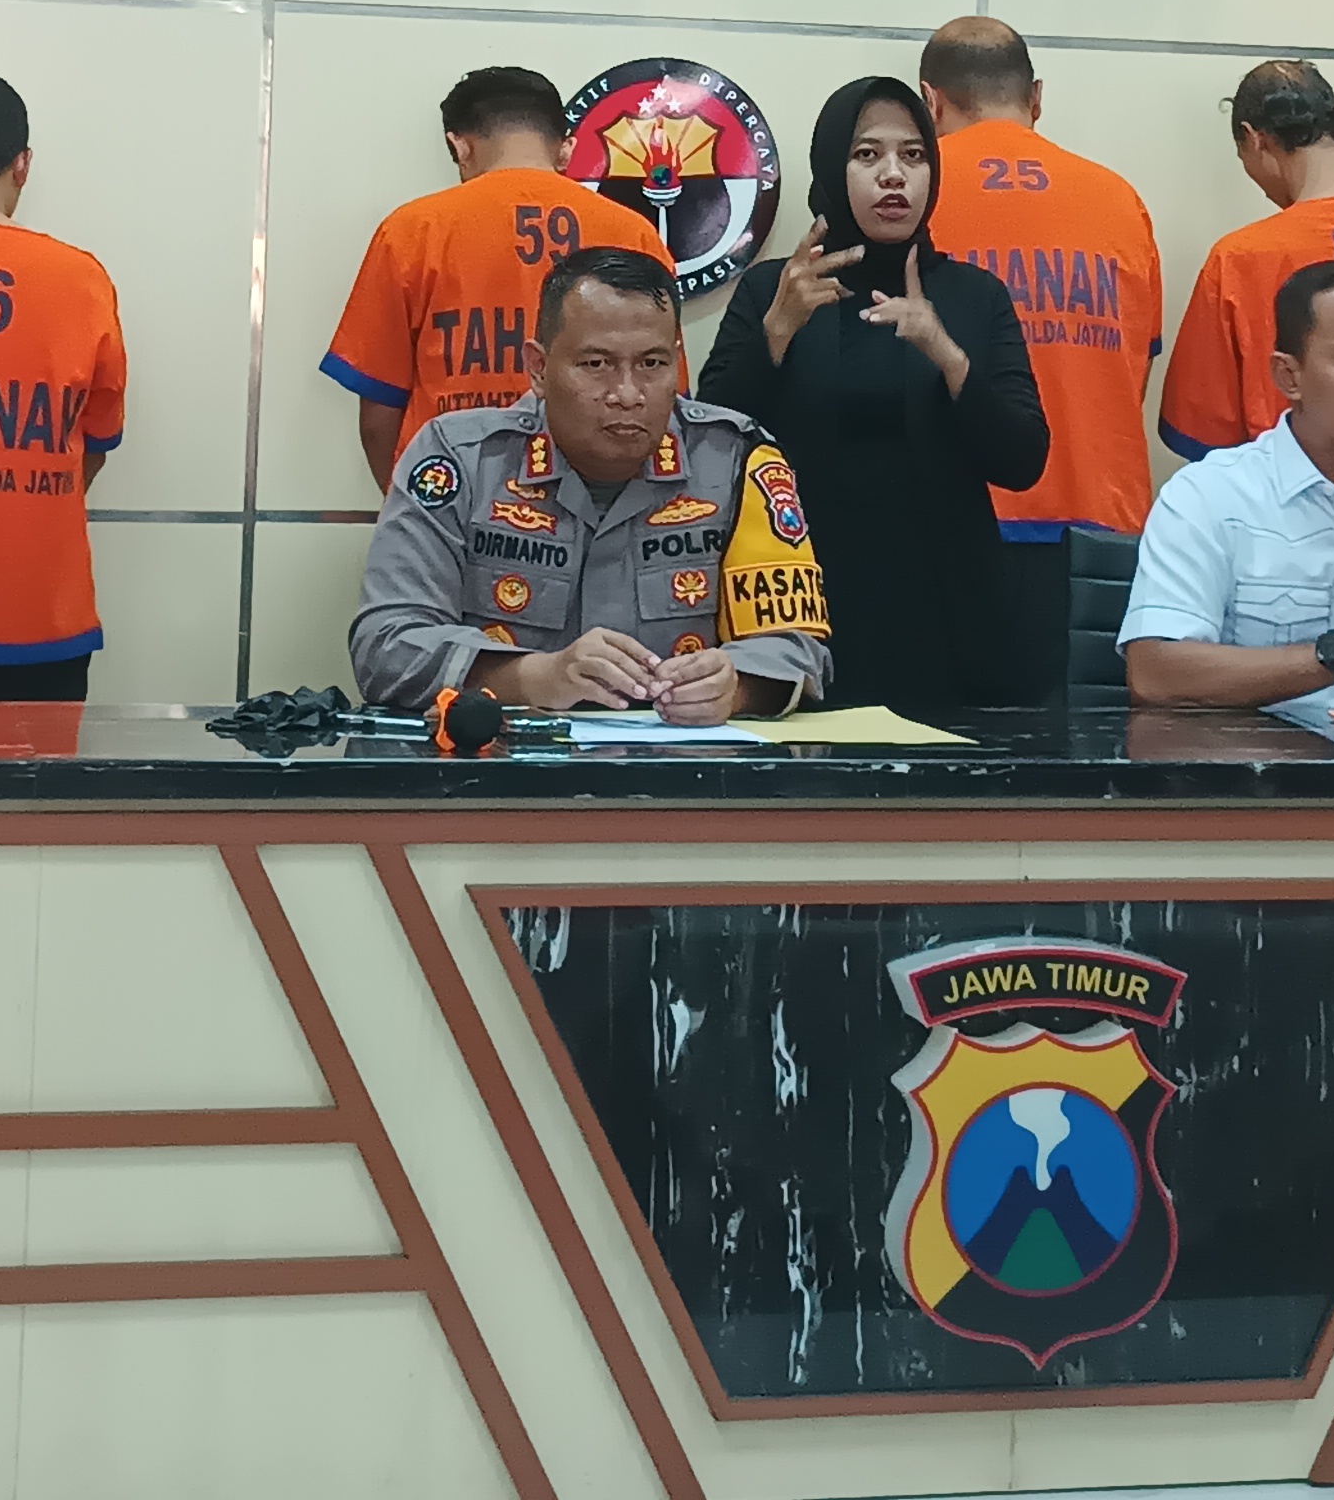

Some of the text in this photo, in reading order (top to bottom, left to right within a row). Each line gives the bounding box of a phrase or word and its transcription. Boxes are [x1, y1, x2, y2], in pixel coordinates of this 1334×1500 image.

[565, 78, 611, 135] KTIF
[699, 73, 774, 191] DIPERCAYA
[978, 158, 1050, 191] 25
[514, 205, 580, 266] 59
[1072, 321, 1121, 352] JATIM
[473, 530, 568, 568] DIRMANTO
[943, 962, 1150, 1005] JAWA TIMUR
